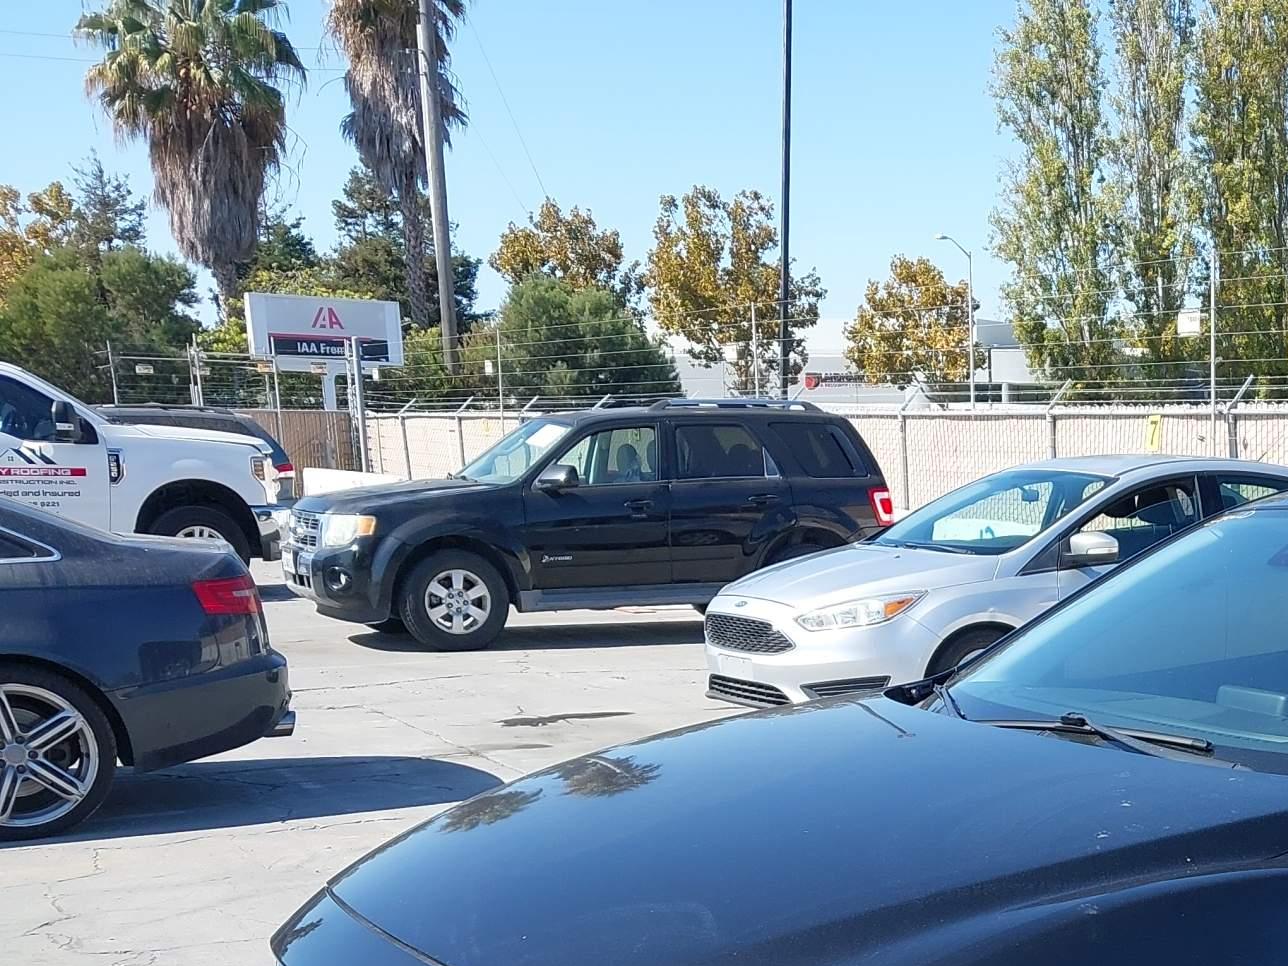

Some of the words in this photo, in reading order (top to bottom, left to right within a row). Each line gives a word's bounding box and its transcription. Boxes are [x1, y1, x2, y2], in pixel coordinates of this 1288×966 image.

[297, 341, 318, 353] IAA
[1150, 421, 1158, 446] 7
[21, 489, 41, 497] and
[42, 488, 80, 497] Insured
